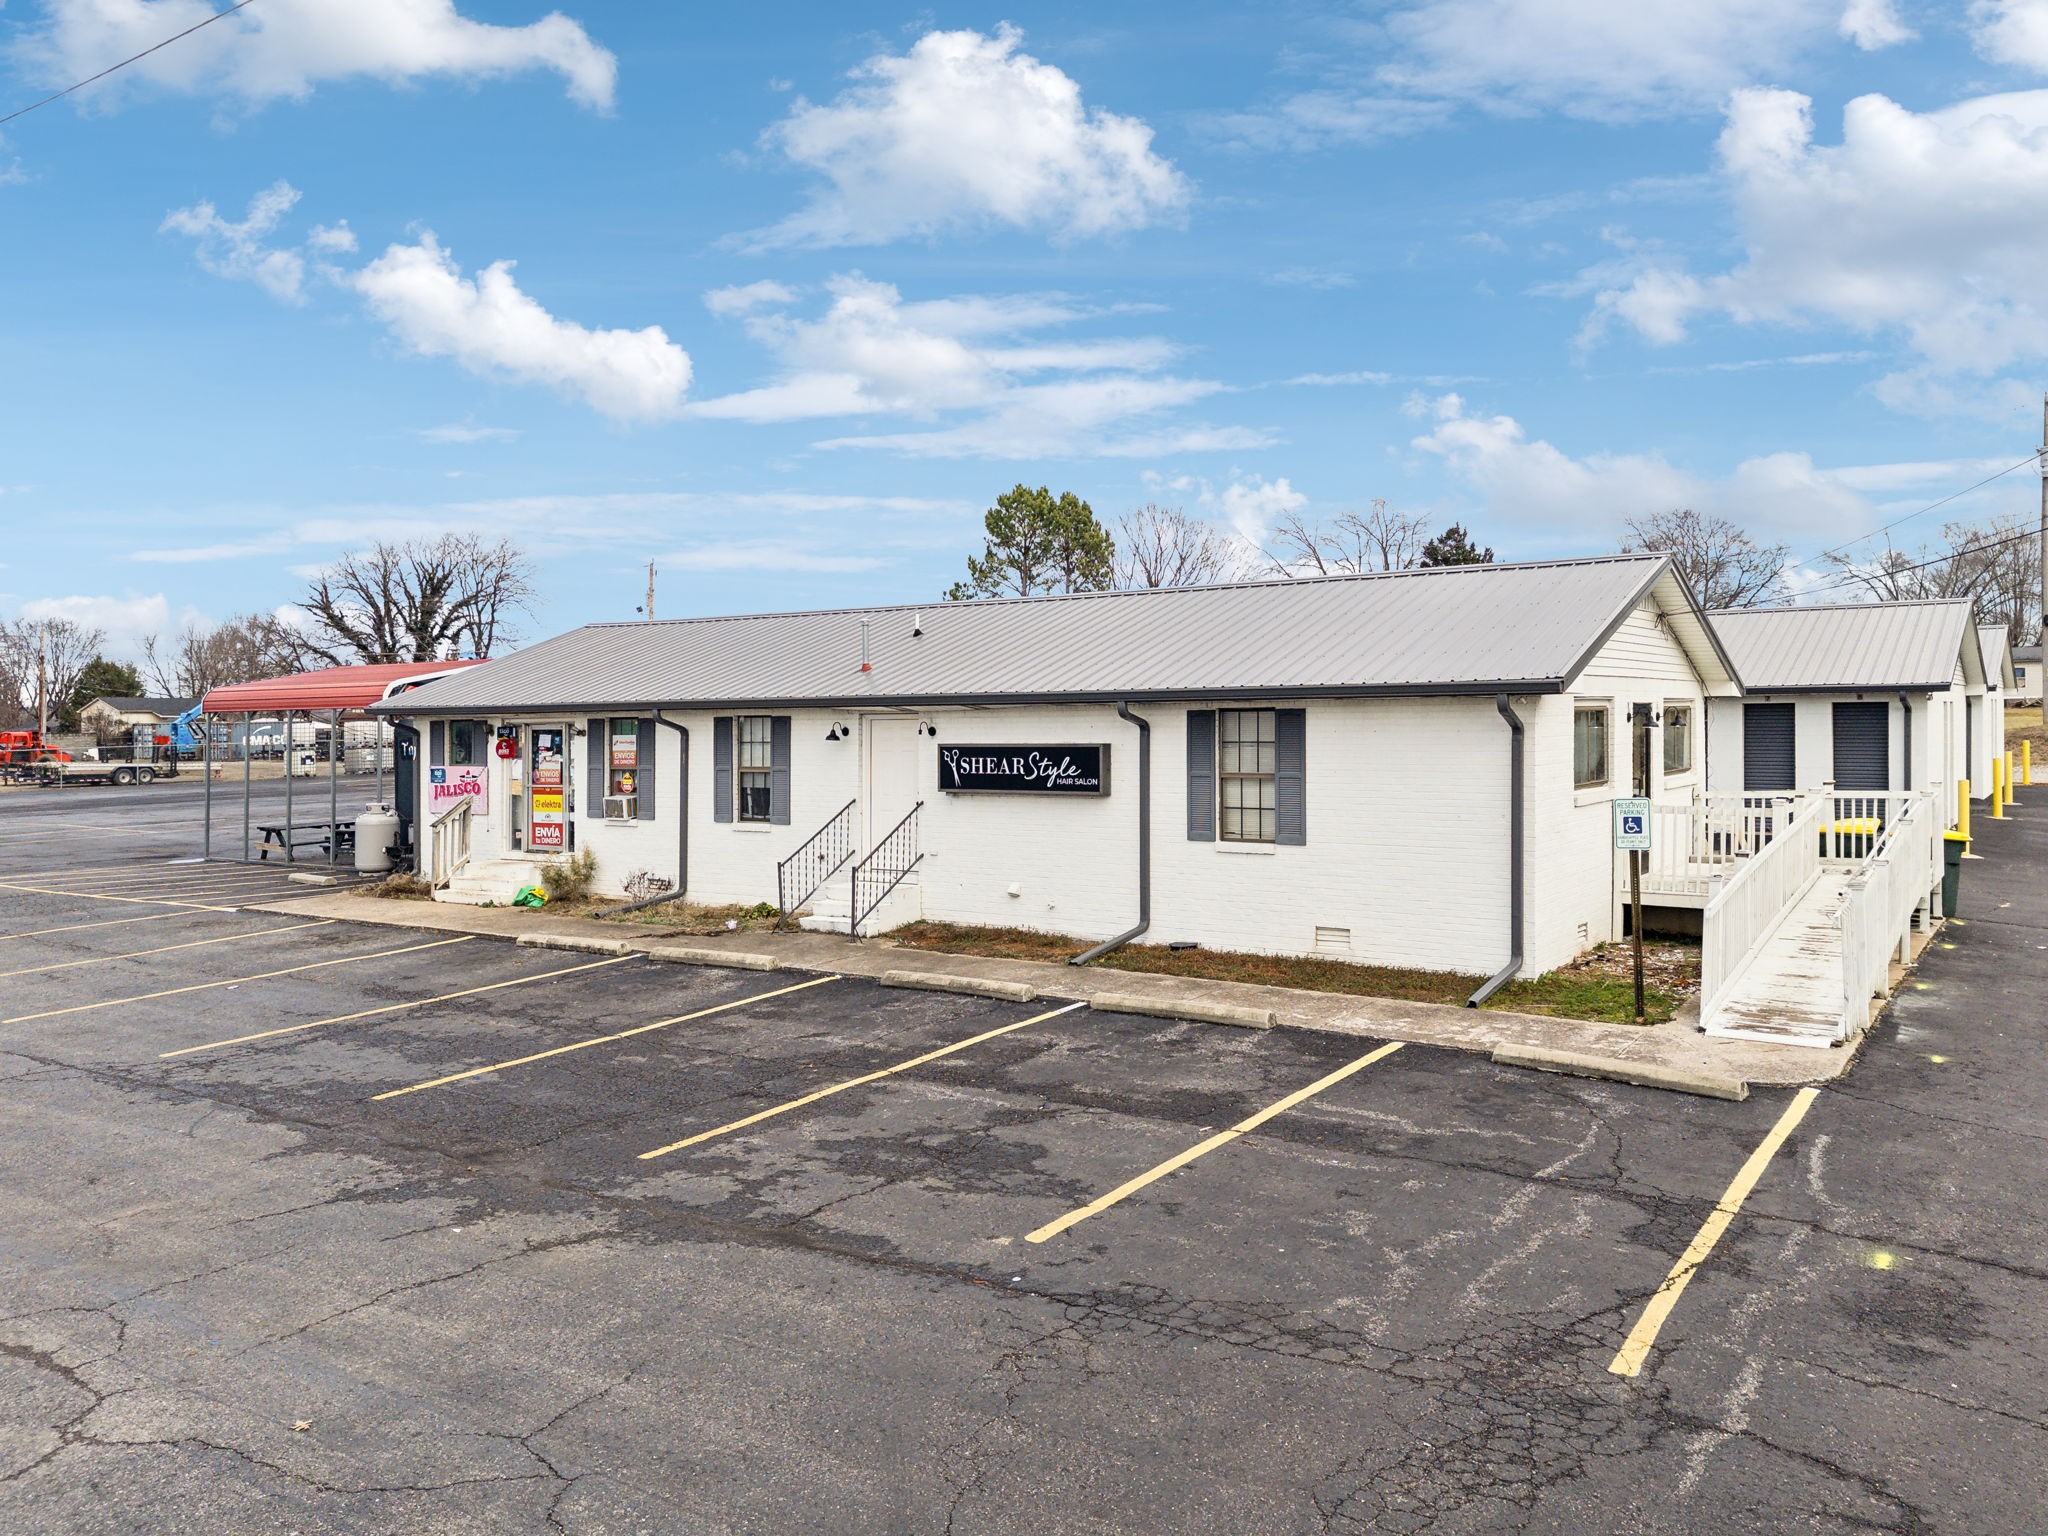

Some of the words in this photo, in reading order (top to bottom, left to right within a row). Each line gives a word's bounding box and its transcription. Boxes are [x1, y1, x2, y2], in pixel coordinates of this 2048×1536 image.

[960, 757, 1025, 775] SHEAR
[1024, 752, 1081, 787] Style
[1056, 777, 1074, 785] HAIR
[1074, 778, 1098, 786] SALON
[434, 781, 481, 800] JALISCO
[541, 799, 562, 809] elektra
[1616, 801, 1648, 809] RESERVED
[535, 824, 560, 838] ENVÍA
